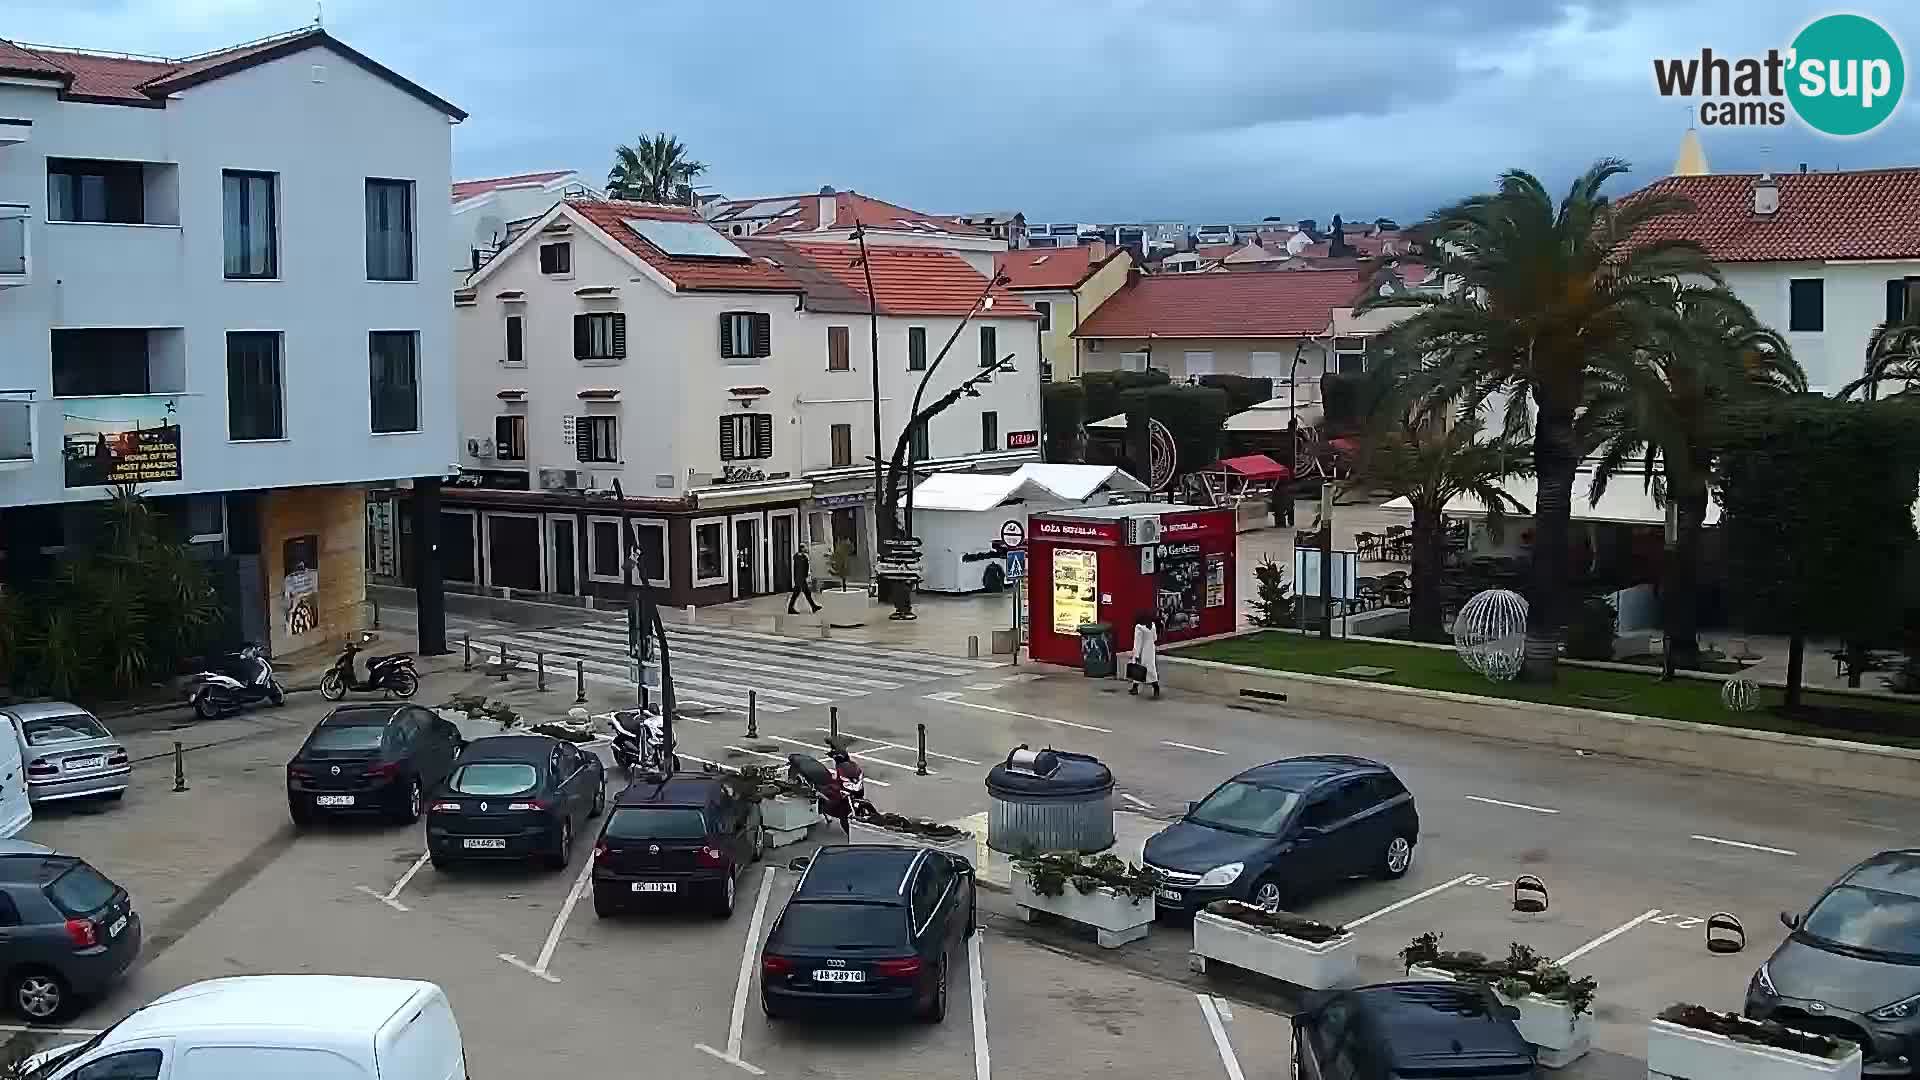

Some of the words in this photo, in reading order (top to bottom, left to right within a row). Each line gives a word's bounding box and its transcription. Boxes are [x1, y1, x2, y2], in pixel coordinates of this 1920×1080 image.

[124, 454, 148, 462] HOME
[117, 463, 139, 471] MOST
[141, 461, 177, 470] AMAZING
[107, 472, 138, 480] SUNSET
